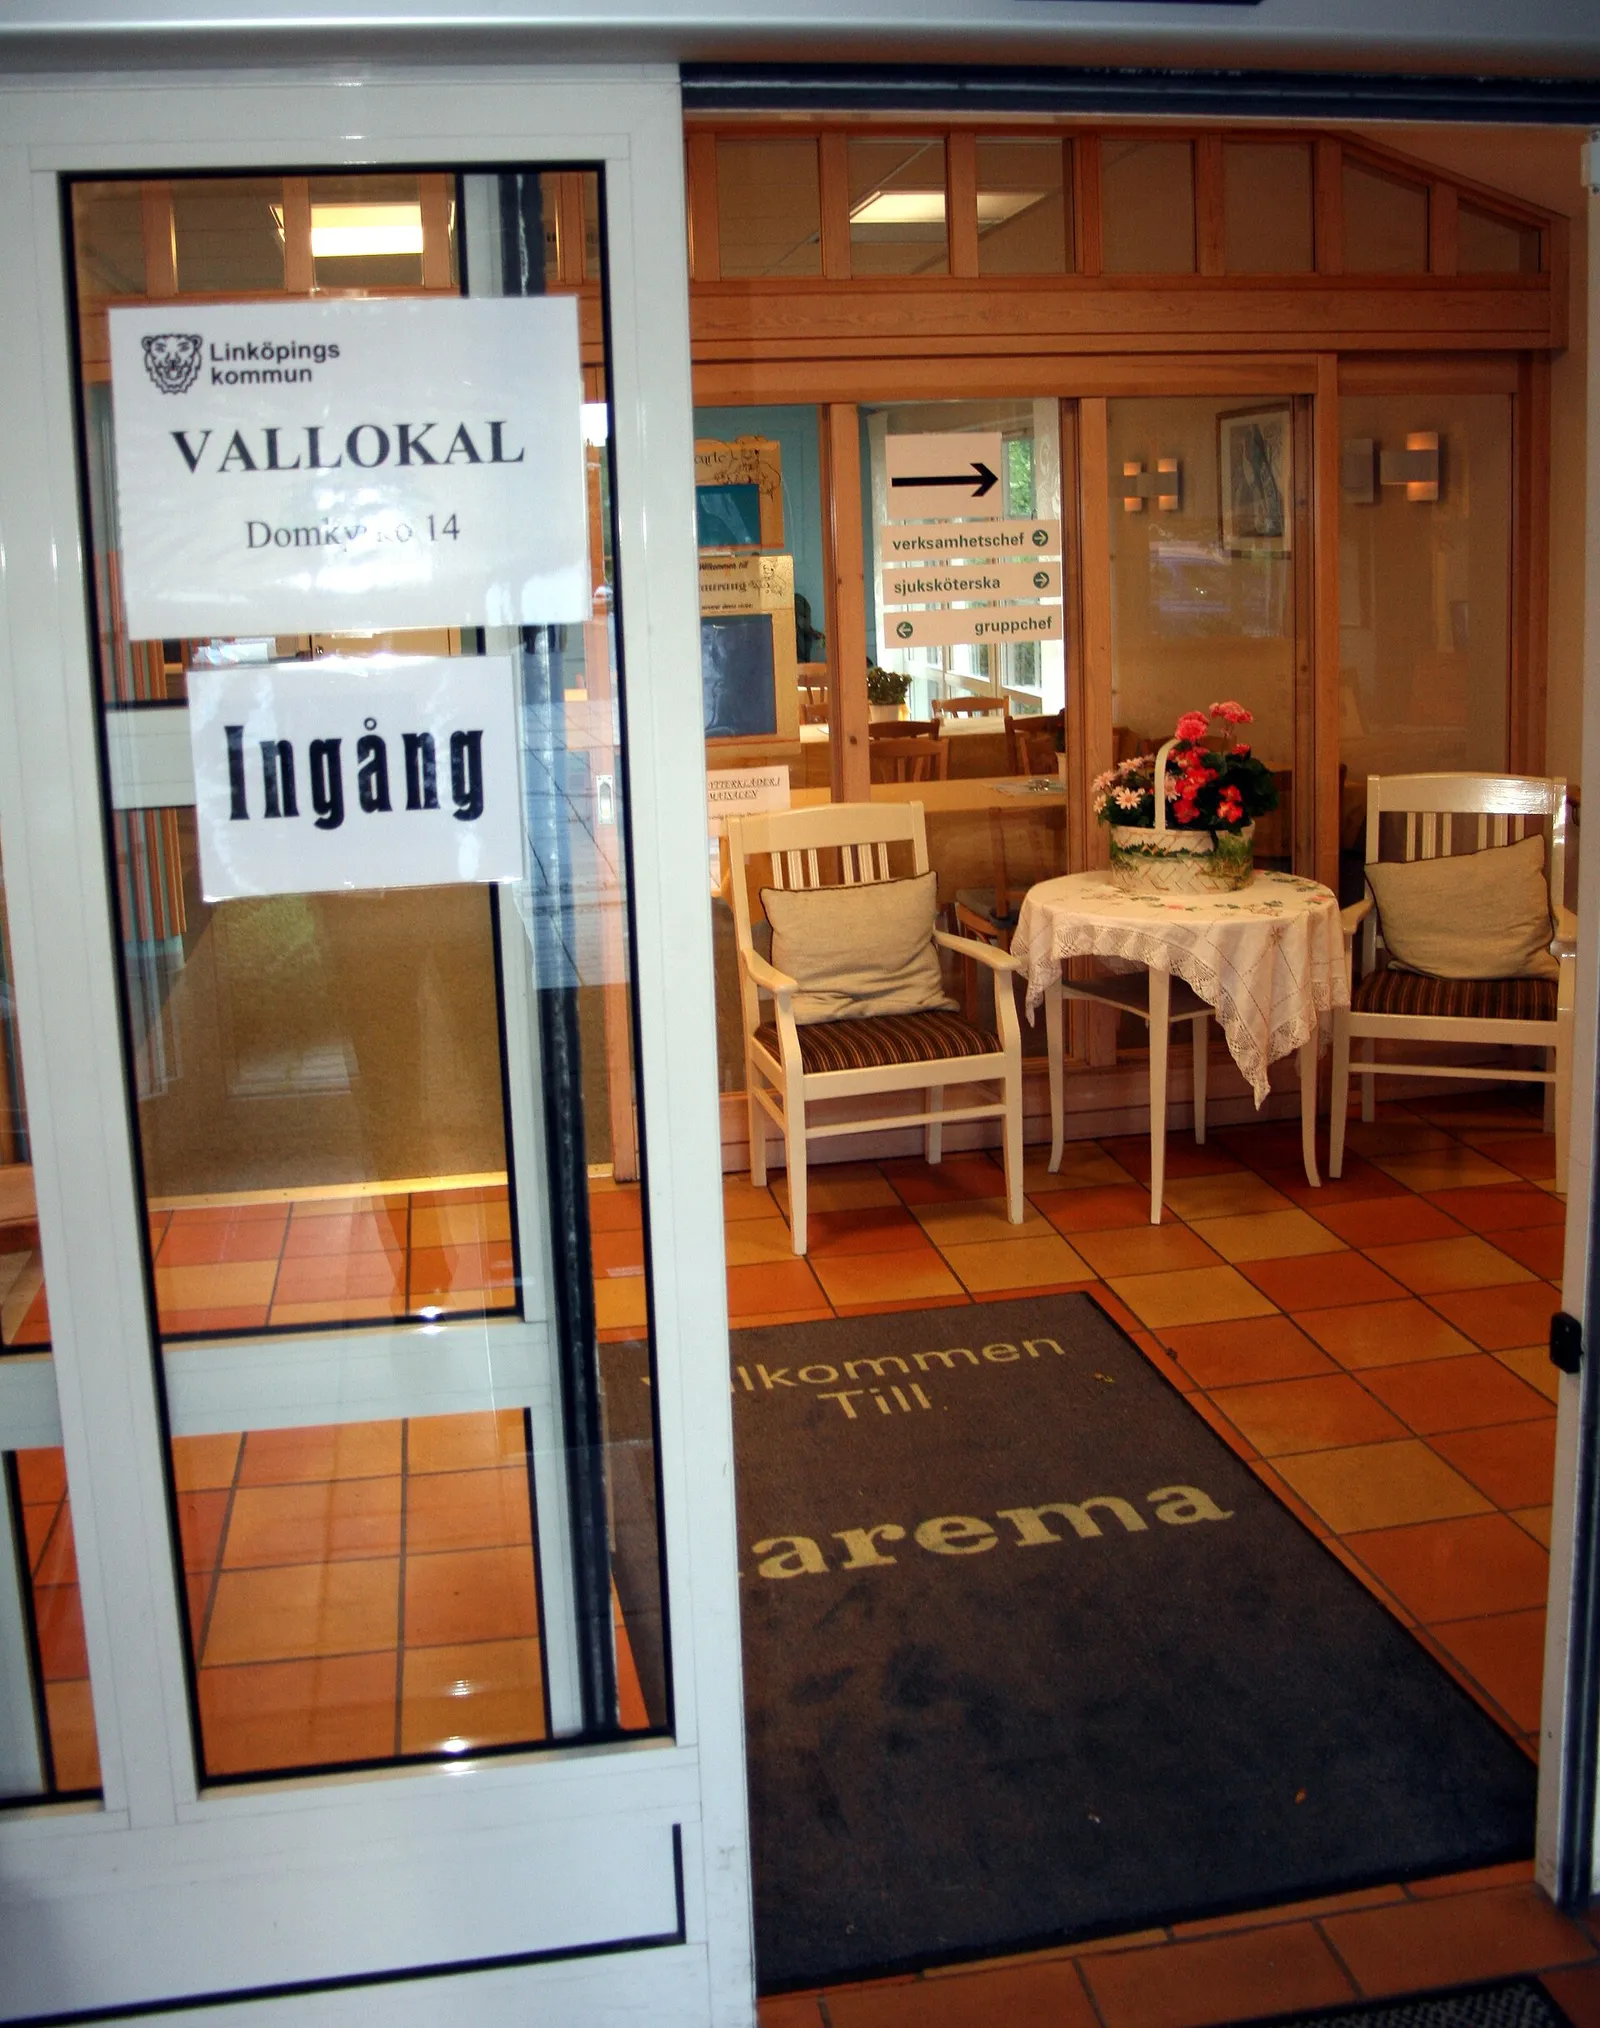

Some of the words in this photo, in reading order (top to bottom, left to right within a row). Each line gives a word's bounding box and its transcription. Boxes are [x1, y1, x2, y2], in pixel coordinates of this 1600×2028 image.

[210, 340, 341, 365] Linköpings
[211, 366, 313, 386] kommun
[170, 420, 525, 474] VALLOKAL
[427, 513, 461, 542] 14
[892, 532, 1025, 551] verksamhetschef
[894, 575, 1001, 597] sjuksköterska
[974, 615, 1053, 636] gruppchef
[223, 717, 485, 831] Ingång
[816, 1383, 934, 1420] Till
[737, 1483, 1236, 1581] arema
